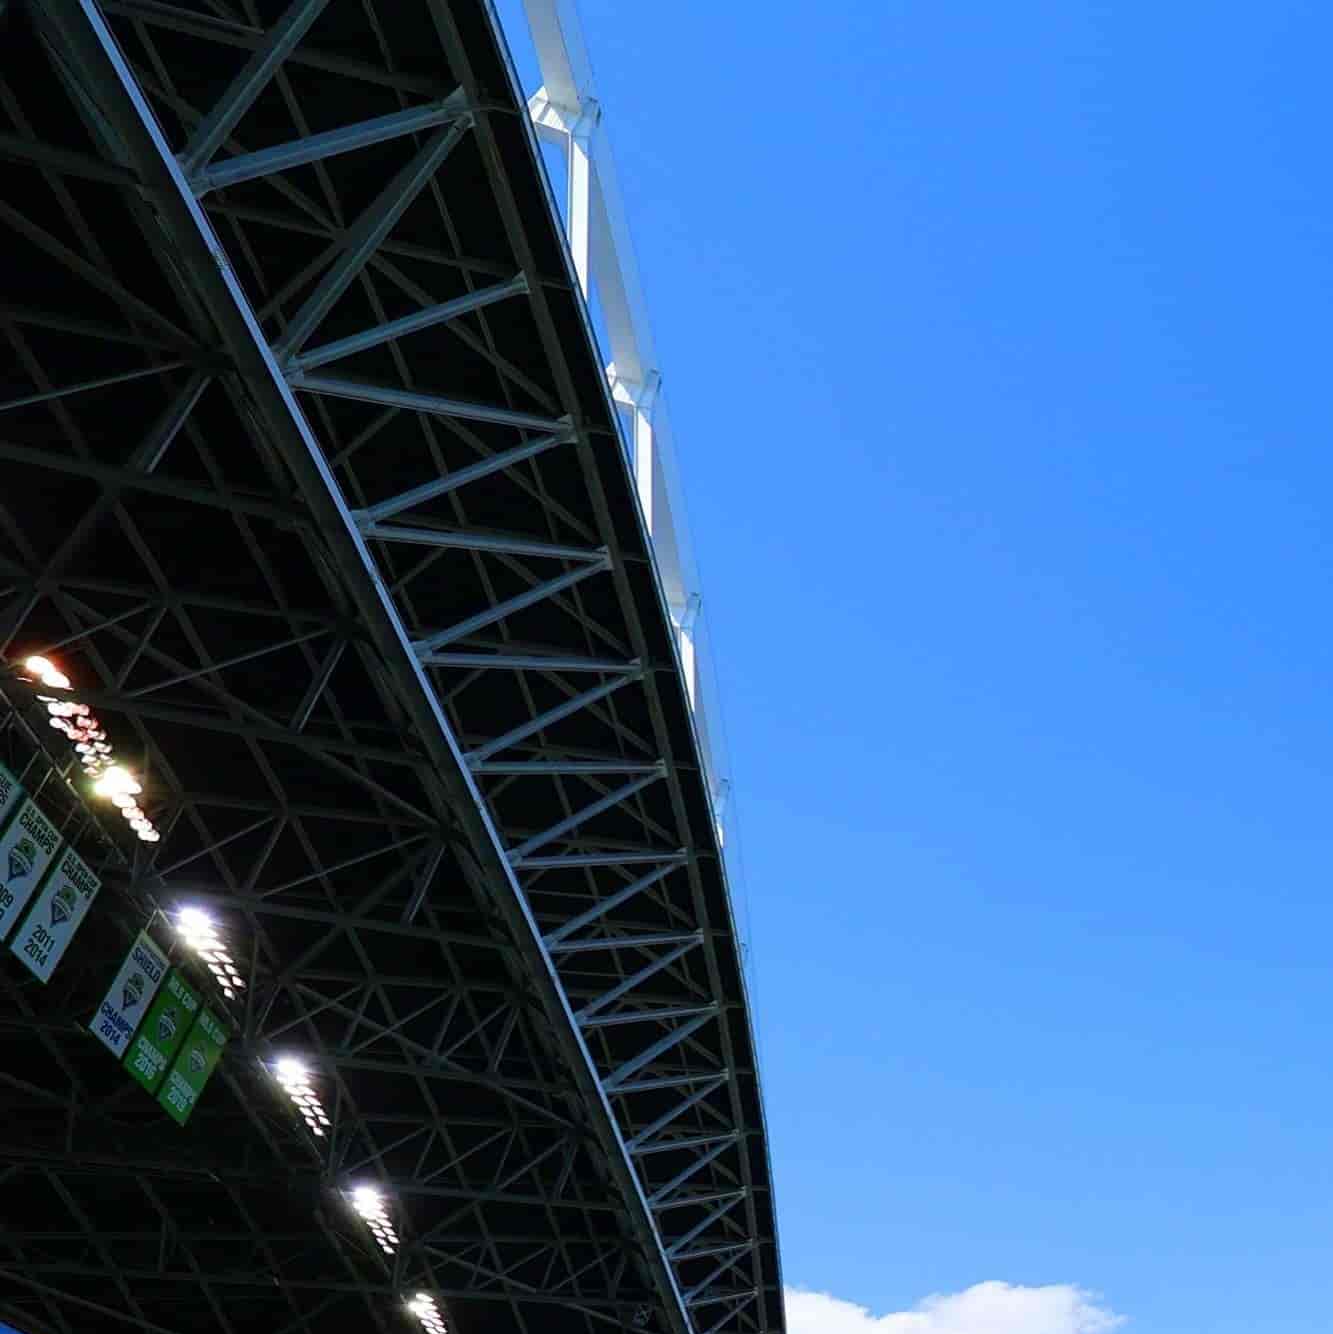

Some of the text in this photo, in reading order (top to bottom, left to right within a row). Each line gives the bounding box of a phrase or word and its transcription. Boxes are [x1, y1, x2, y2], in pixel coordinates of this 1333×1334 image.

[19, 812, 56, 855] CHAMPS
[61, 859, 95, 899] CHAMPS
[32, 924, 56, 950] 2011
[24, 940, 48, 969] 2014
[131, 945, 161, 985] SHIELD
[100, 1019, 121, 1047] 2014
